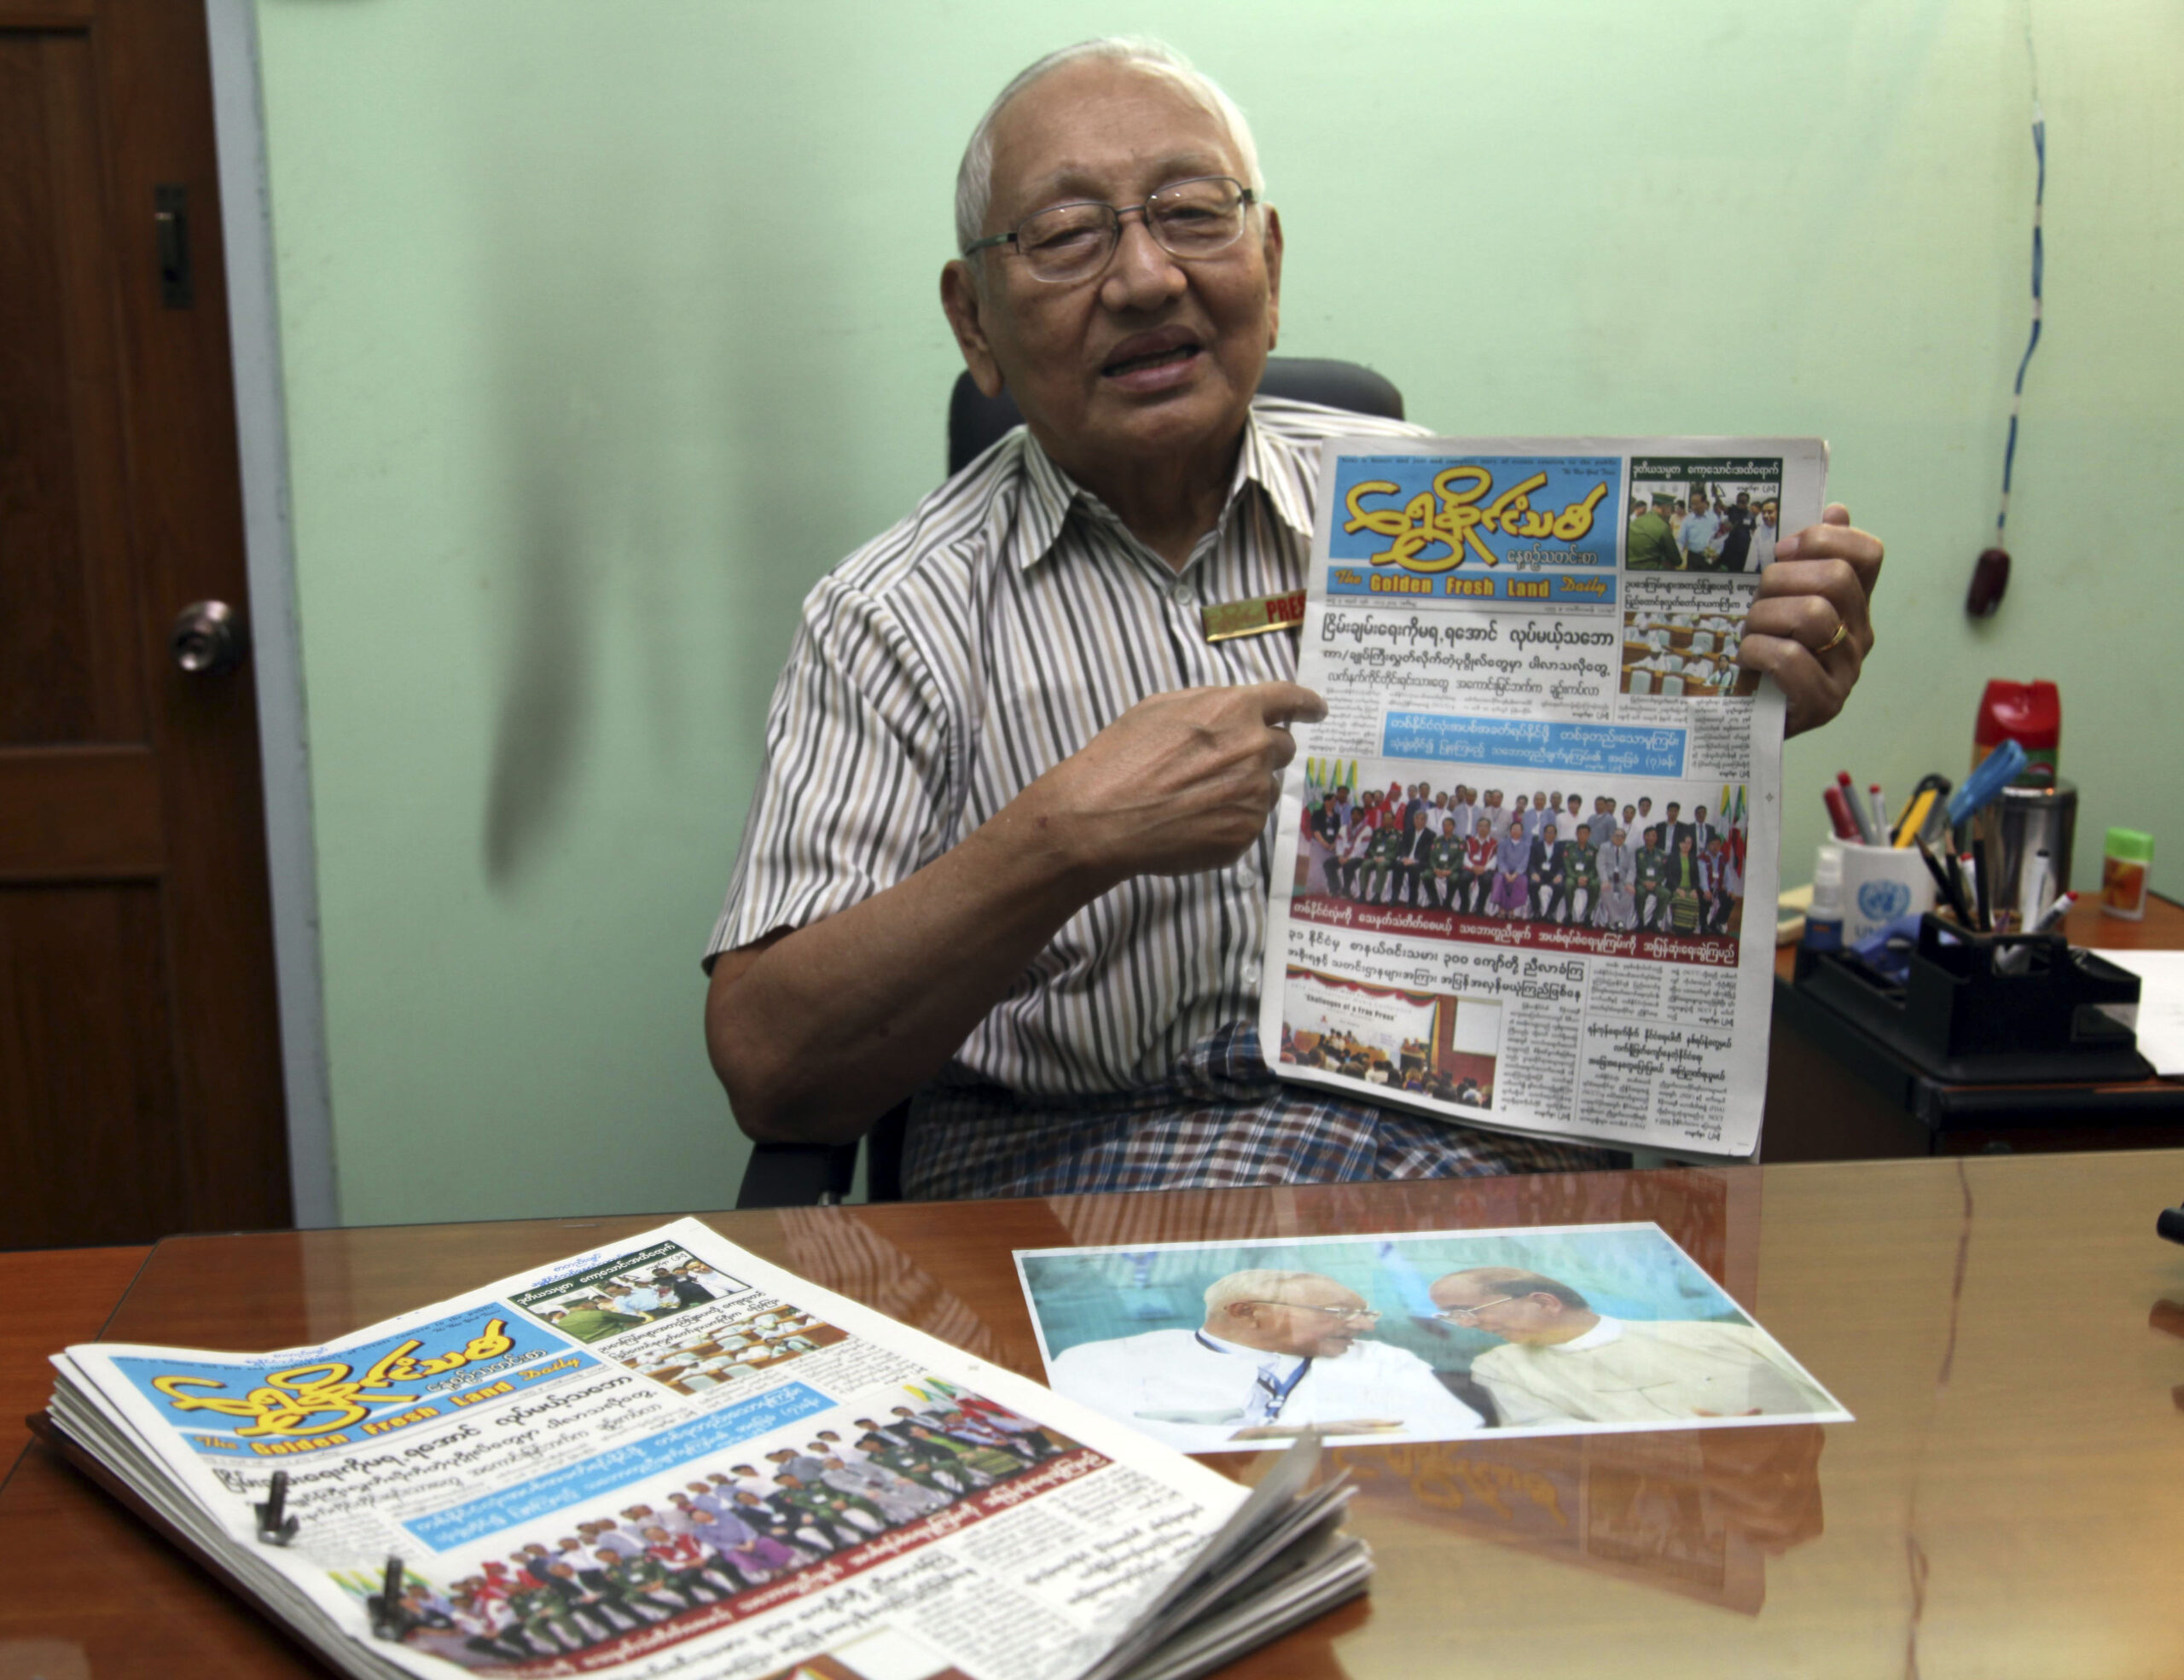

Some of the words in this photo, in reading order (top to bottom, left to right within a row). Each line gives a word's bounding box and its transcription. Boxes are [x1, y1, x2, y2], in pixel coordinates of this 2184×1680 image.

[1334, 569, 1362, 585] The
[1370, 574, 1433, 595] Golden
[1446, 576, 1495, 596] Fresh
[1507, 579, 1551, 598] Land
[1560, 576, 1607, 596] Daily
[194, 1434, 239, 1451] The
[250, 1432, 351, 1456] Golden
[362, 1405, 442, 1437] Fresh
[449, 1381, 516, 1408] Land
[519, 1357, 581, 1382] Daily
